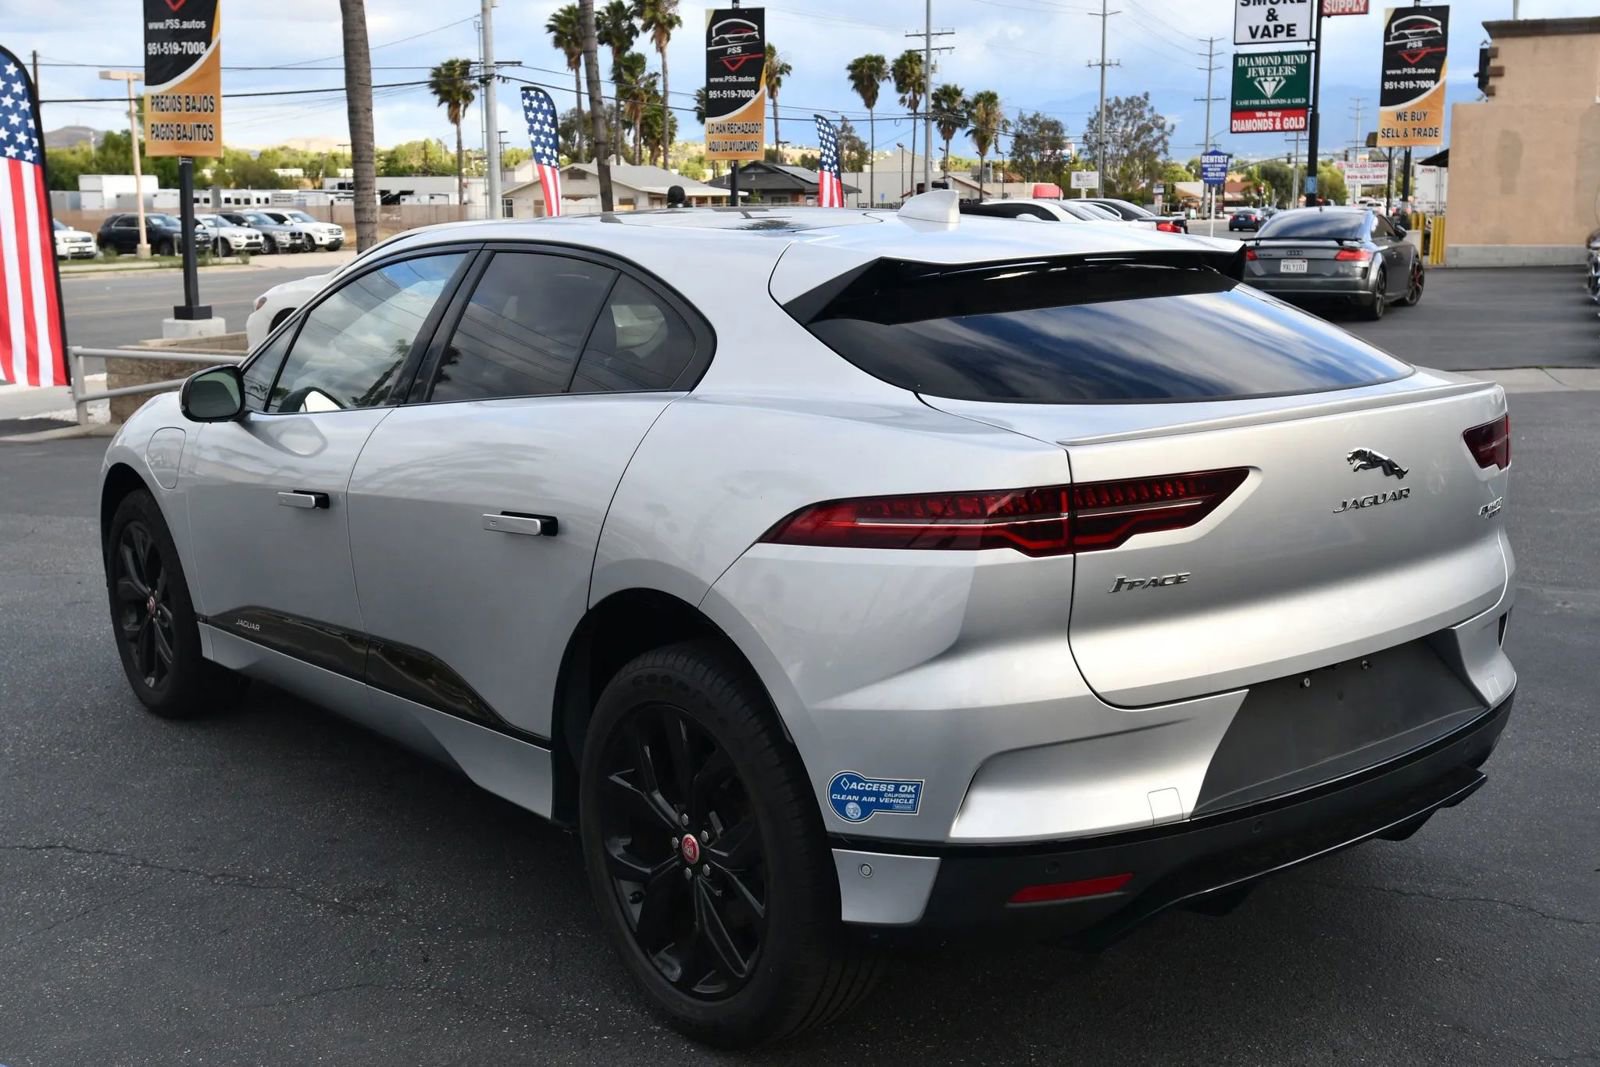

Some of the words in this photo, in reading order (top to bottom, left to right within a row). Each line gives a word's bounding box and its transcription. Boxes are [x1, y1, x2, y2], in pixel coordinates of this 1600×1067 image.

[1322, 0, 1367, 13] SUPPLY
[1265, 7, 1279, 22] &
[147, 19, 206, 30] www.PSS.autos
[1248, 24, 1297, 39] VAPE
[146, 41, 207, 55] 951-519-7008
[726, 46, 742, 54] PSS
[1406, 40, 1423, 49] PSS
[1237, 56, 1281, 67] DIAMOND
[1282, 54, 1308, 65] MIND
[1246, 66, 1297, 78] JEWELERS
[1385, 67, 1436, 75] www.PSS.autos
[709, 75, 756, 83] www.PSS.autos
[1384, 80, 1435, 90] 951-519-7008
[708, 89, 756, 99] 951-519-7008
[150, 95, 182, 112] PRECIOS
[185, 95, 215, 112] BAJOS
[1396, 111, 1408, 121] WE
[1410, 111, 1428, 121] BUY
[708, 122, 715, 134] LO
[716, 122, 726, 134] HAN
[1231, 118, 1274, 132] DIAMONDS
[1275, 118, 1282, 130] &
[1283, 116, 1306, 130] GOLD
[150, 123, 175, 141] PAGOS
[176, 123, 214, 141] BAJITOS
[1381, 128, 1400, 138] SELL
[1402, 127, 1409, 138] &
[1412, 127, 1439, 138] TRADE
[1201, 155, 1228, 163] DENTIST
[1333, 487, 1411, 513] JAGUAR
[235, 618, 261, 631] JAGUAR
[849, 782, 895, 792] ACCESS
[831, 793, 860, 801] CLEAN
